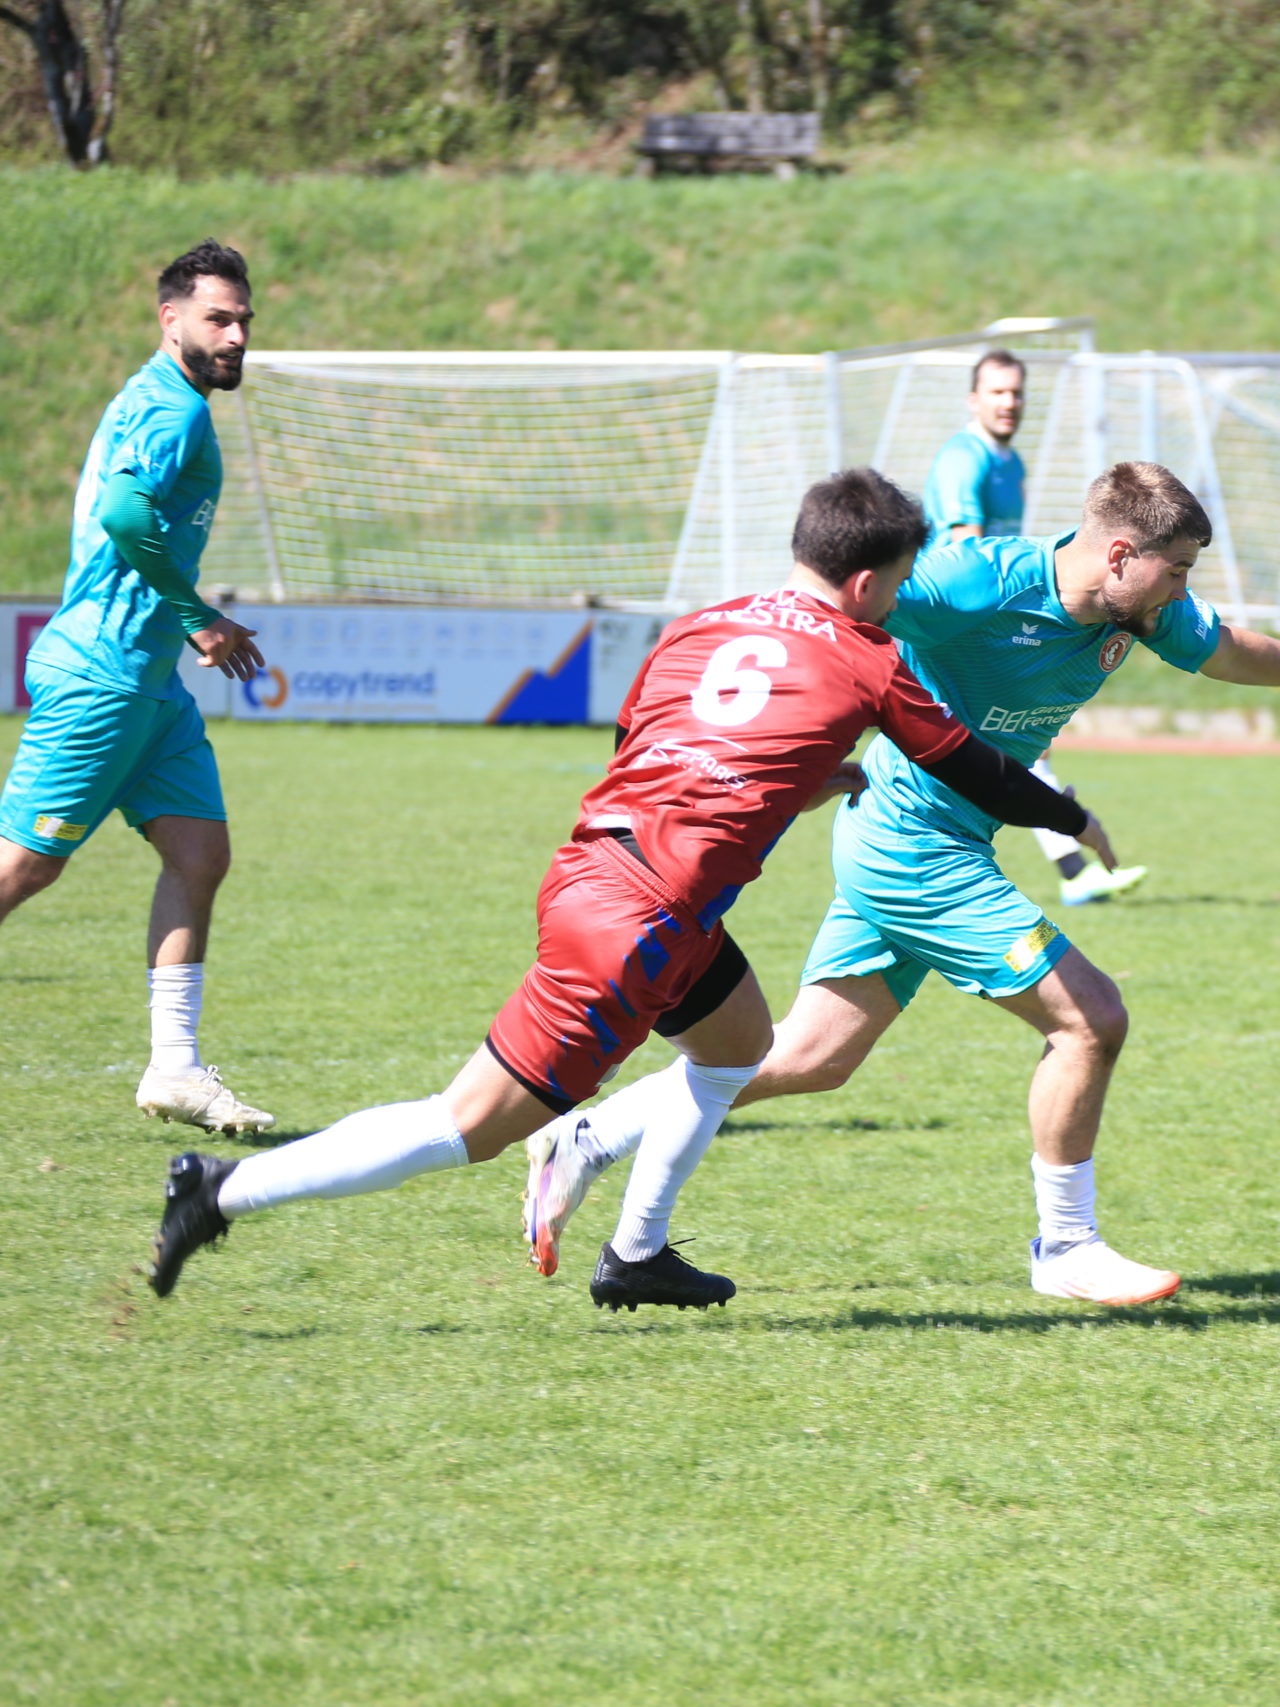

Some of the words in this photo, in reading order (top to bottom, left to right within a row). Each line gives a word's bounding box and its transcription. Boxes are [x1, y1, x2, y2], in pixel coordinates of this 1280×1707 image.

[1012, 635, 1042, 647] erima
[293, 668, 435, 702] copytrend
[690, 634, 788, 727] 6
